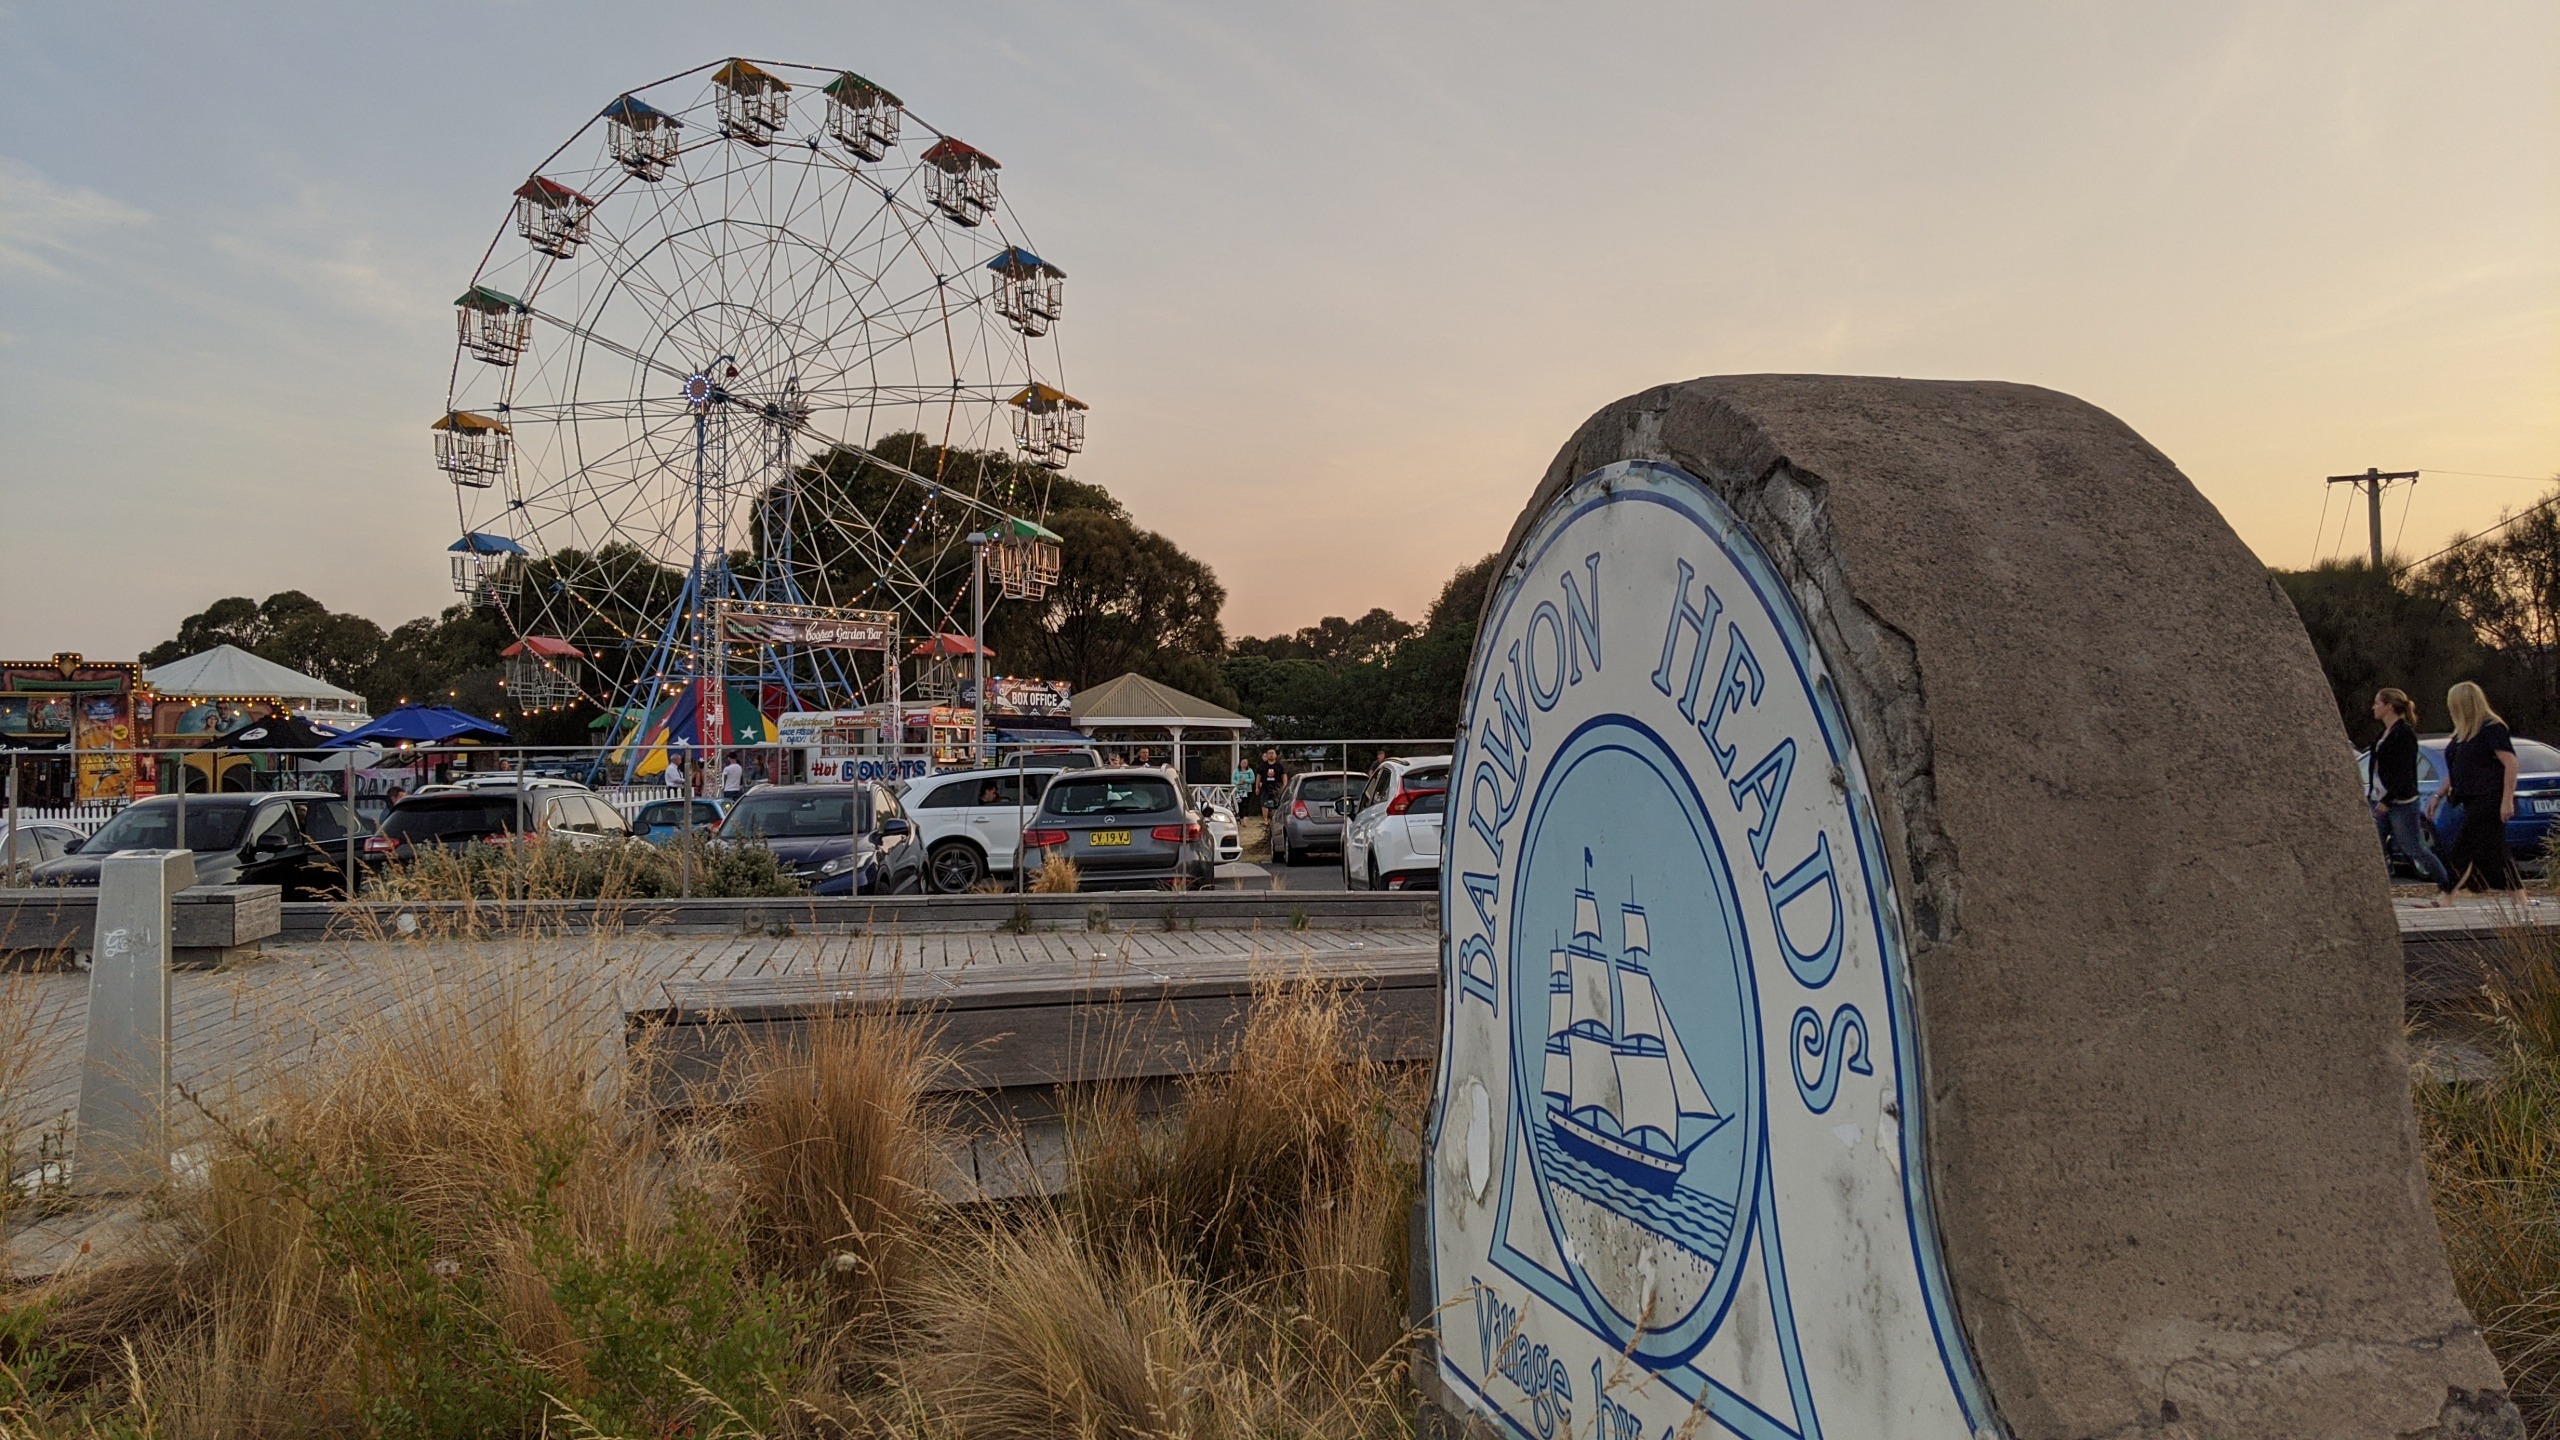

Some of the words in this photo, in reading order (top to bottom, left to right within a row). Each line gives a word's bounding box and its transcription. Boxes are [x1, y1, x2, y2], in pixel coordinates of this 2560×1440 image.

[836, 627, 866, 643] Garden
[866, 627, 883, 640] Bar
[1011, 691, 1028, 705] BOX
[1030, 693, 1058, 707] OFFICE
[836, 717, 867, 725] Twisted
[779, 728, 795, 736] MADE
[795, 728, 815, 736] FRESH
[811, 757, 838, 777] Hot
[841, 759, 927, 782] DONUTS
[1458, 551, 1601, 1019] BARWON
[1651, 556, 1875, 1115] HEADS
[1471, 1275, 1573, 1440] Village
